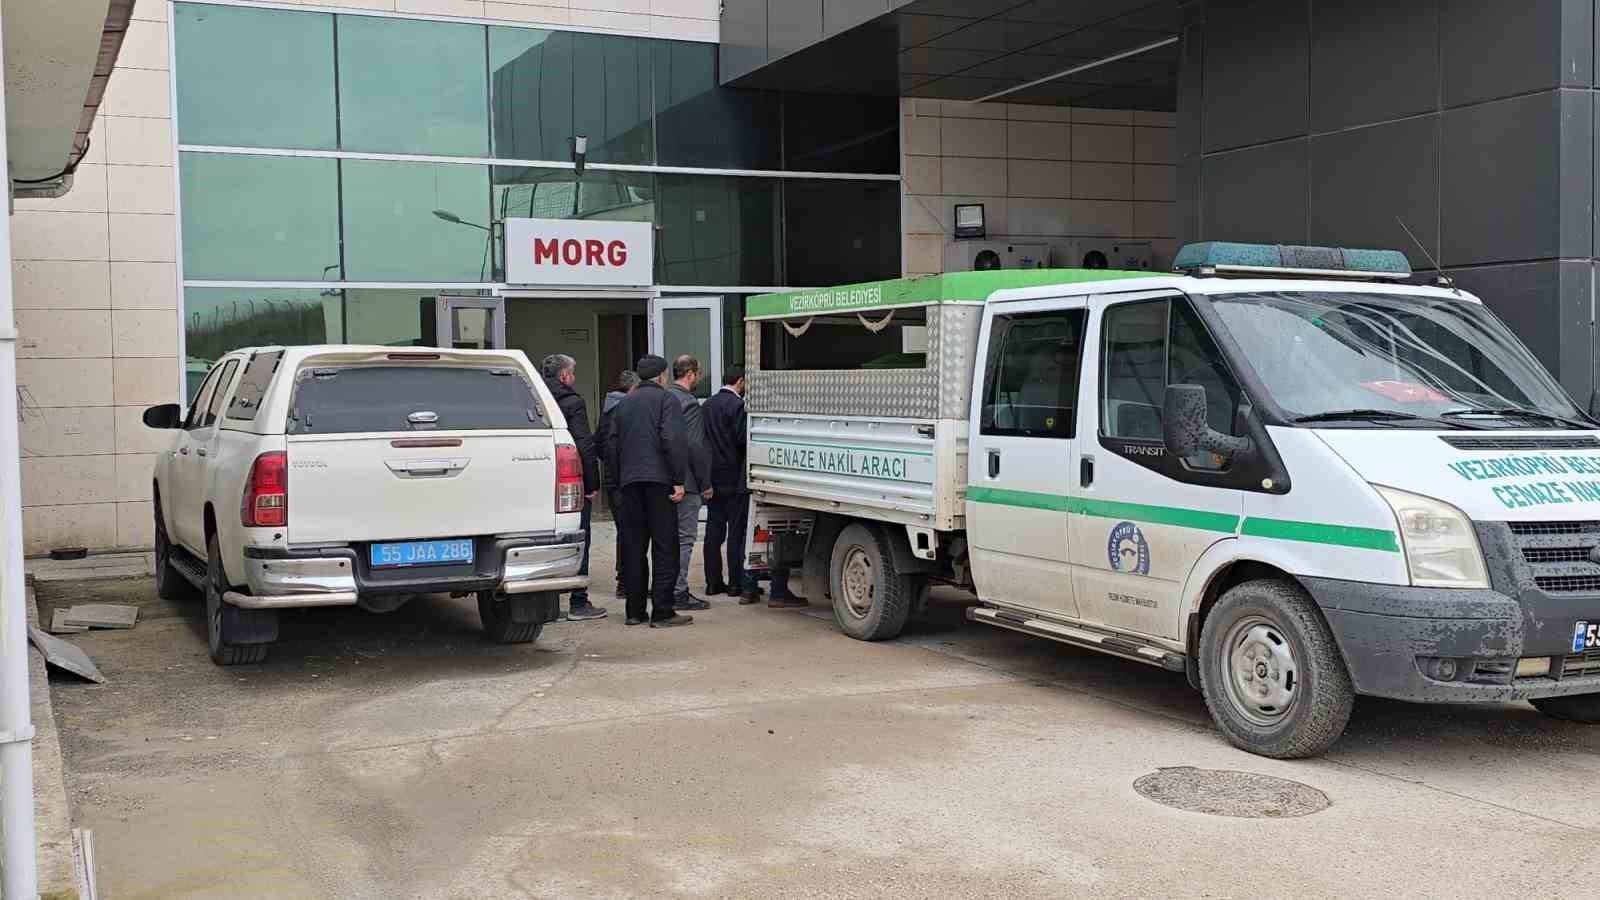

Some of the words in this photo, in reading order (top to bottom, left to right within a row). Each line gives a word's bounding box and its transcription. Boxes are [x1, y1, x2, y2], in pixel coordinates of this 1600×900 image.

[534, 238, 628, 267] MORG
[835, 284, 881, 306] BELEDİYESİ
[768, 447, 815, 469] CENAZE
[818, 450, 857, 473] NAKİL
[861, 456, 906, 478] ARACI
[1124, 445, 1165, 457] TRANSIT
[1492, 481, 1574, 509] CENAZE
[383, 545, 401, 562] 55
[407, 543, 437, 561] JAA
[441, 542, 470, 560] 286
